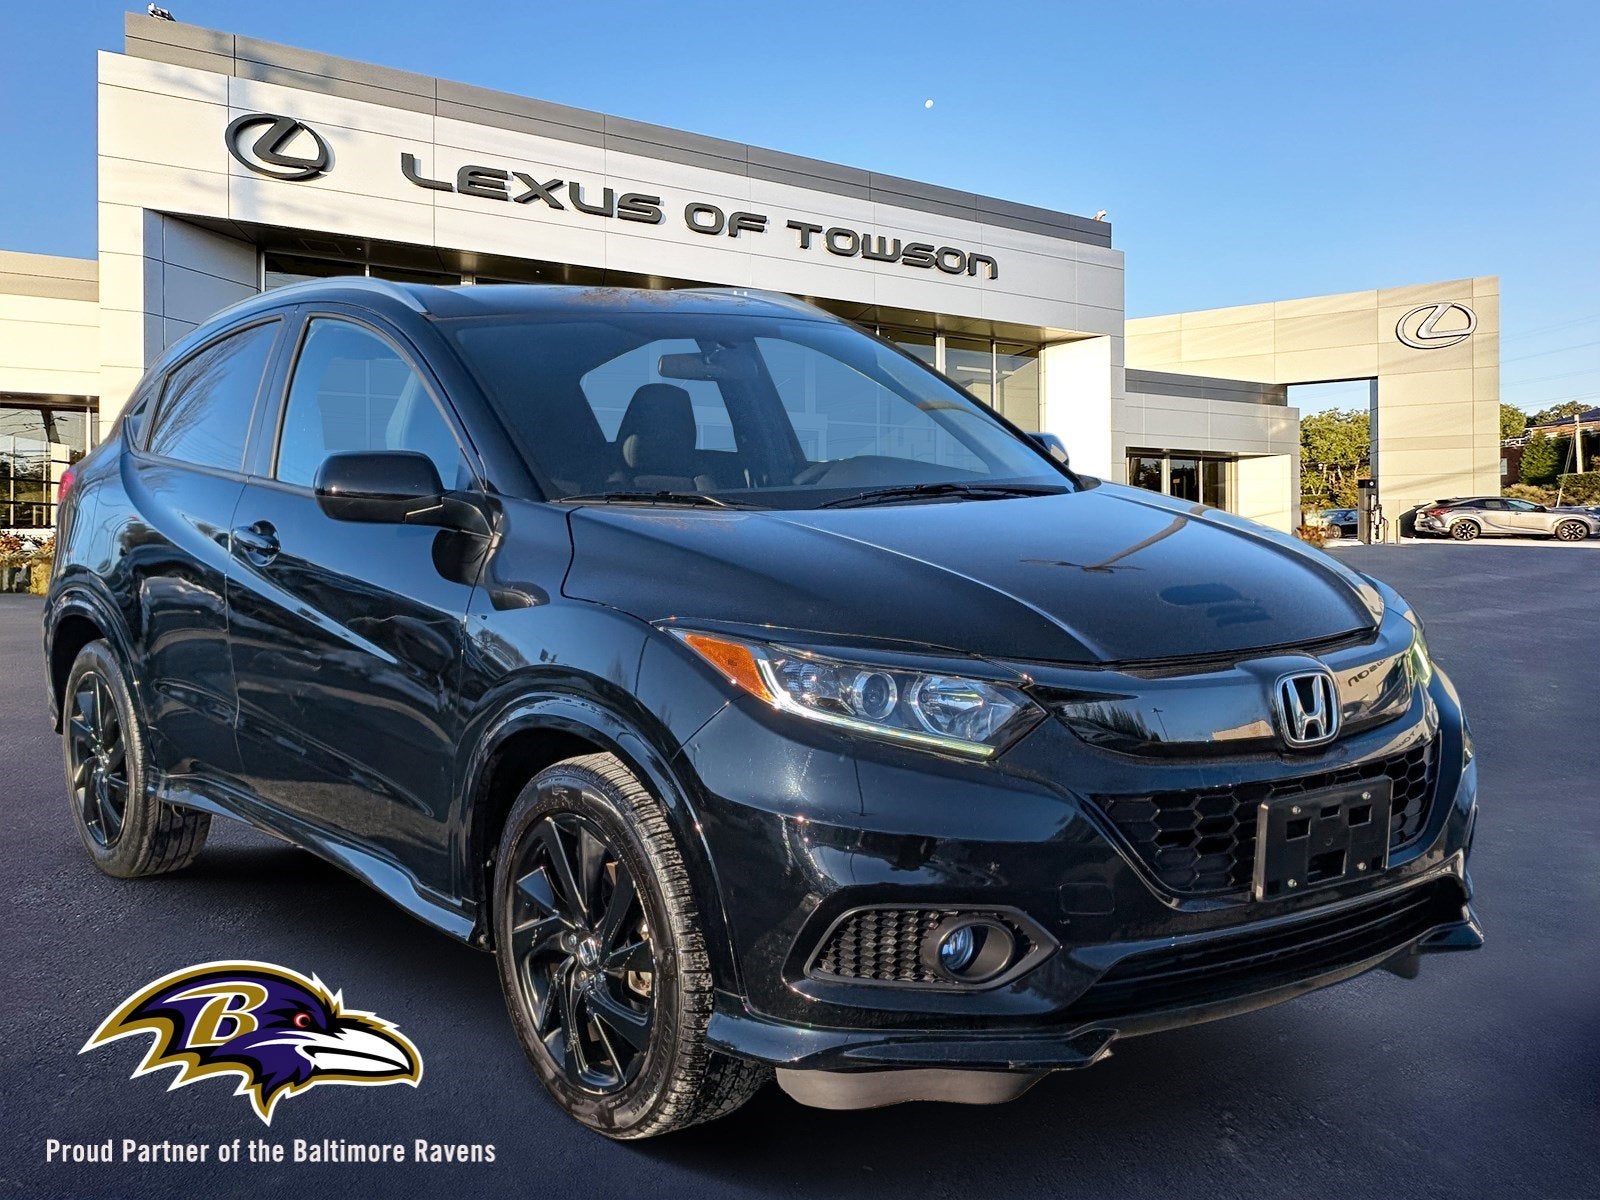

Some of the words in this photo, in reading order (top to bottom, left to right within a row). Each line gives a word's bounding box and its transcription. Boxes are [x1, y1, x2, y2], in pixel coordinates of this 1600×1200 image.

[400, 152, 664, 225] LEXUS
[684, 201, 768, 238] OF
[786, 219, 999, 280] TOWSON
